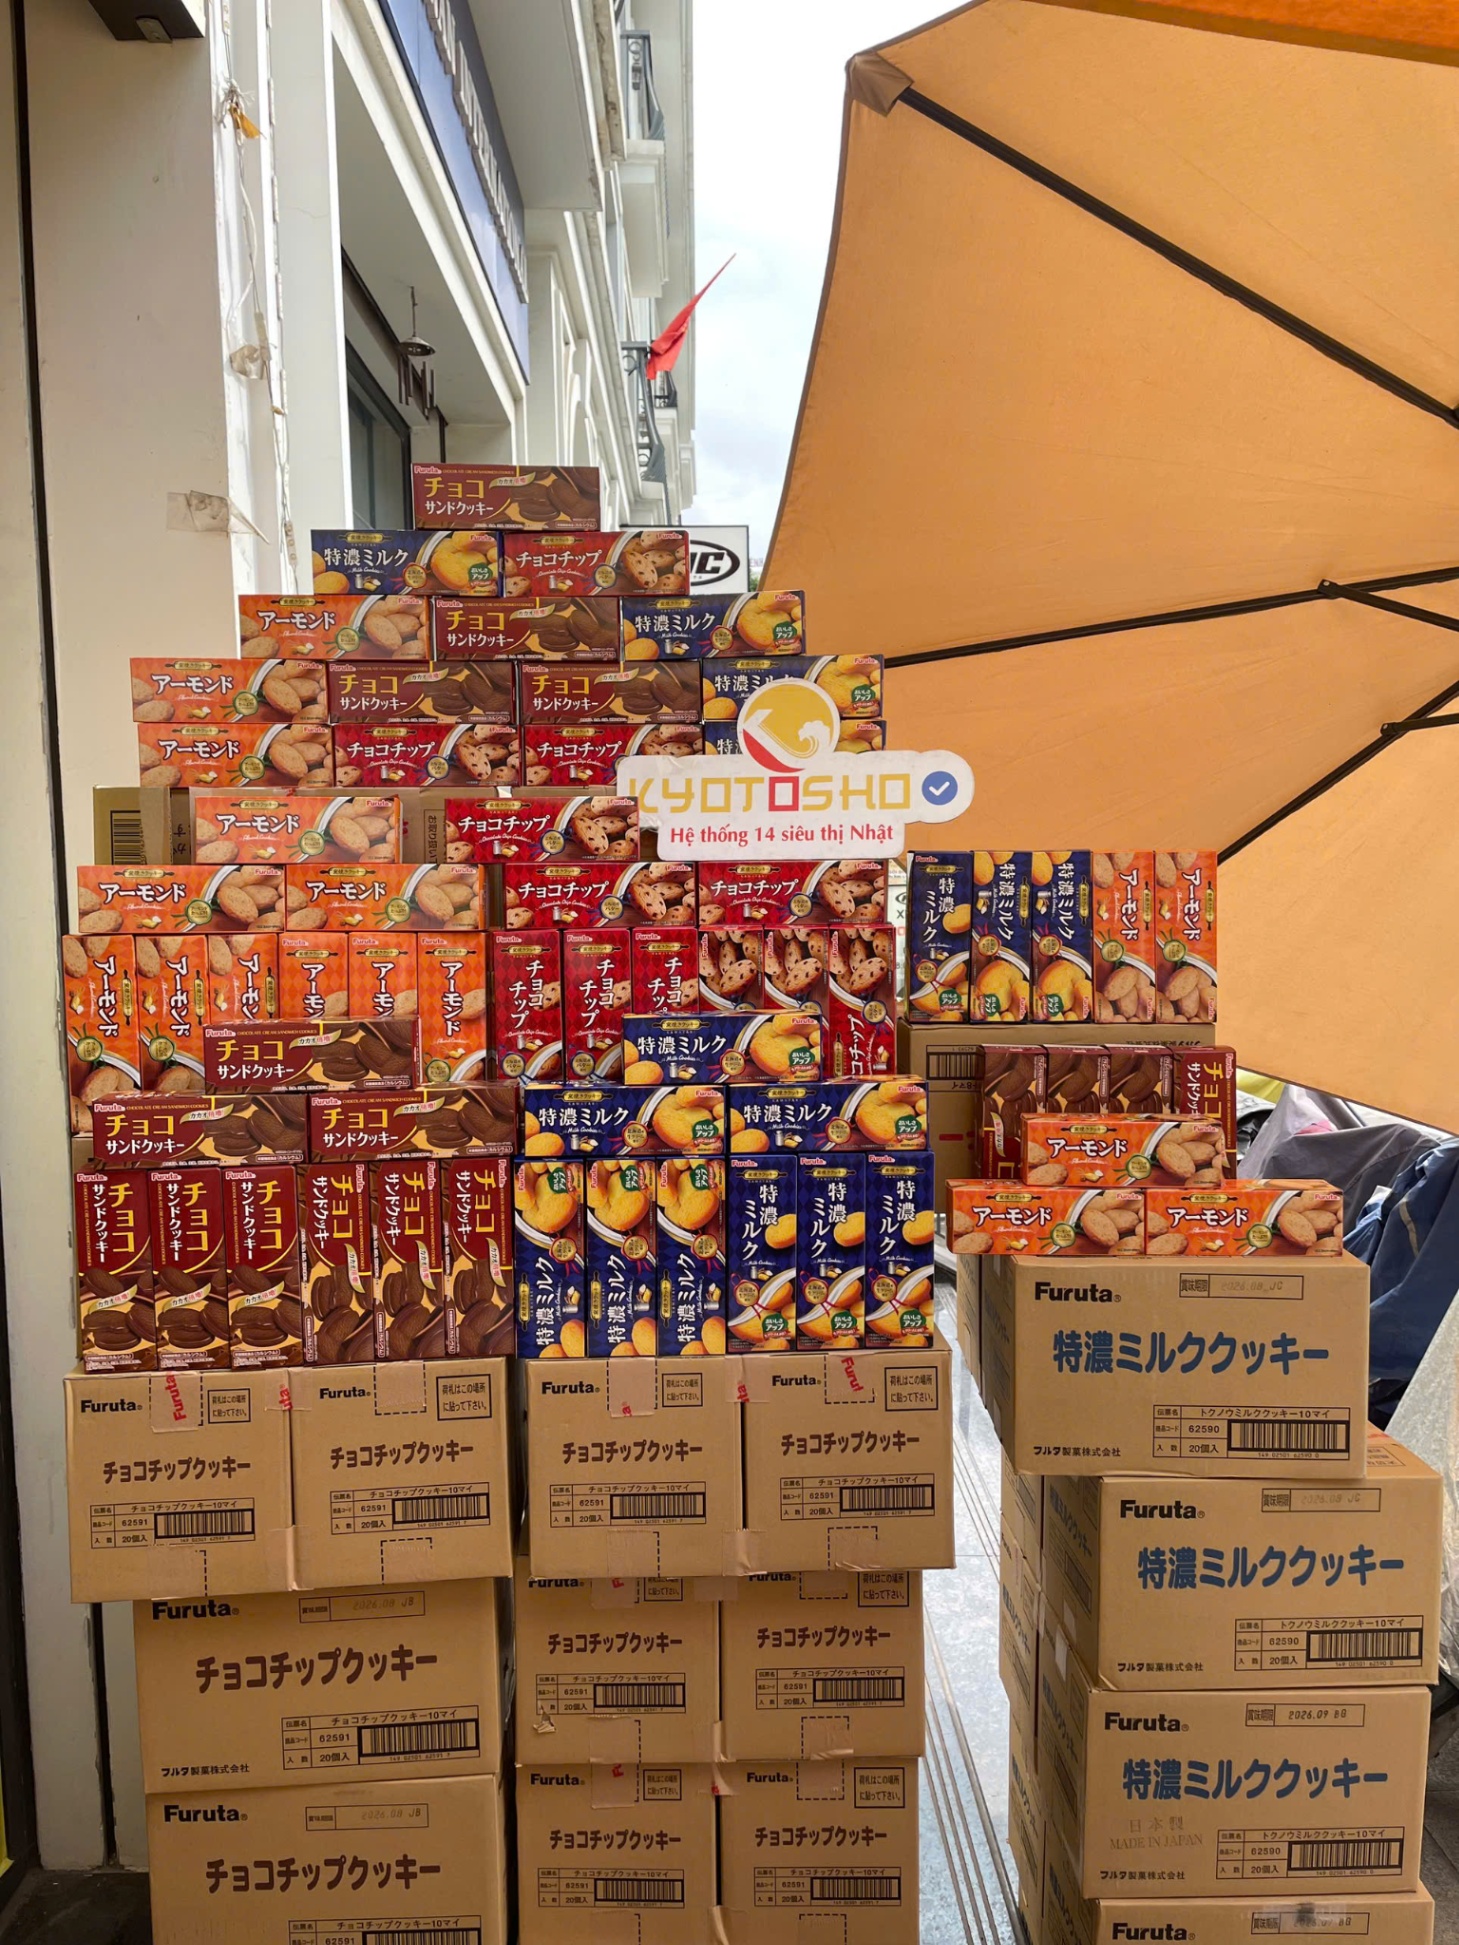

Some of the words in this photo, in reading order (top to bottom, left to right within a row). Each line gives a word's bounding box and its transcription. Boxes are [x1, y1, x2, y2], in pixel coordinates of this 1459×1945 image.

[424, 477, 484, 498] チョコ
[425, 501, 493, 516] サンドクッキー
[324, 548, 408, 567] 特濃ミルク
[516, 550, 602, 567] チョコチップ
[257, 611, 336, 631] アーモンド
[446, 610, 504, 630] チョコ
[635, 612, 715, 632] 特濃ミルク
[447, 633, 514, 647] サンドクッキー
[151, 674, 233, 694] アーモンド
[339, 674, 397, 694] チョコ
[532, 674, 589, 695] チョコ
[340, 697, 407, 710] サンドクッキー
[533, 697, 598, 711] サンドクッキー
[158, 739, 240, 759] アーモンド
[348, 742, 435, 758] チョコチップ
[537, 741, 622, 758] チョコチップ
[630, 774, 911, 813] KYOTOSHO
[216, 813, 300, 835] アーモンド
[458, 816, 550, 833] チョコチップ
[671, 828, 694, 843] Hệ
[701, 823, 748, 847] thống
[756, 826, 775, 842] 14
[782, 825, 814, 842] siêu
[821, 825, 843, 844] thị
[851, 824, 893, 846] Nhật
[99, 882, 186, 903] アーモンド
[306, 881, 387, 902] アーモンド
[519, 881, 609, 899] チョコチップ
[711, 879, 799, 897] チョコチップ
[938, 877, 956, 913] 特濃
[998, 863, 1015, 941] 特濃ミルク
[1058, 863, 1075, 940] 特濃ミルク
[1119, 868, 1139, 941] アーモンド
[1181, 868, 1202, 941] アーモンド
[922, 890, 940, 943] ミルク
[526, 960, 544, 1008] チョコ
[597, 959, 615, 1006] チョコ
[665, 957, 683, 1004] チョコ
[94, 955, 119, 1037] アーモンド
[166, 955, 191, 1037] アーモンド
[440, 961, 464, 1037] アーモンド
[509, 980, 530, 1028] チップ
[579, 979, 599, 1028] チップ
[216, 1040, 283, 1062] チョコ
[637, 1035, 727, 1055] 特濃ミルク
[217, 1064, 294, 1079] サンドクッキー
[1203, 1062, 1223, 1118] チョコ
[322, 1108, 388, 1130] チョコ
[539, 1107, 629, 1127] 特濃ミルク
[743, 1103, 833, 1123] 特濃ミルク
[105, 1114, 174, 1137] チョコ
[106, 1139, 185, 1155] サンドクッキー
[322, 1131, 399, 1148] サンドクッキー
[1047, 1138, 1127, 1159] アーモンド
[800, 1158, 826, 1166] Furuta
[869, 1155, 895, 1163] Furuta
[77, 1174, 108, 1182] Furuta
[151, 1172, 182, 1181] Furuta
[226, 1171, 256, 1180] Furuta
[331, 1174, 354, 1238] チョコ
[384, 1173, 401, 1246] サンドクッキー
[402, 1172, 426, 1235] チョコ
[456, 1171, 473, 1243] サンドクッキー
[473, 1169, 497, 1233] チョコ
[759, 1185, 779, 1226] 特濃
[827, 1182, 847, 1224] 特濃
[896, 1181, 916, 1222] 特濃
[108, 1183, 135, 1253] チョコ
[166, 1183, 183, 1261] サンドクッキー
[182, 1181, 209, 1252] チョコ
[241, 1181, 256, 1260] サンドクッキー
[256, 1180, 282, 1249] チョコ
[312, 1176, 330, 1249] サンドクッキー
[972, 1206, 1052, 1227] アーモンド
[1167, 1207, 1249, 1228] アーモンド
[92, 1184, 109, 1263] サンドクッキー
[741, 1199, 762, 1261] ミルク
[810, 1197, 831, 1259] ミルク
[879, 1195, 900, 1256] ミルク
[535, 1256, 555, 1345] 特濃ミルク
[607, 1255, 626, 1344] 特濃ミルク
[677, 1253, 696, 1343] 特濃ミルク
[1035, 1281, 1113, 1303] Furuta
[1053, 1330, 1329, 1376] 特濃ミルククッキー
[772, 1375, 816, 1386] Furuta
[842, 1357, 864, 1392] Furut
[164, 1372, 187, 1421] Furuta
[320, 1386, 366, 1400] Furuta
[542, 1381, 594, 1394] Furuta
[81, 1399, 137, 1413] Furuta
[1156, 1407, 1179, 1417] 伝票名
[1200, 1408, 1331, 1419] トクノウミルククッキー10マイ
[1188, 1424, 1220, 1435] 62590
[562, 1439, 702, 1464] チョコチップクッキー
[781, 1430, 920, 1456] チョコチップクッキー
[1033, 1445, 1121, 1458] フルタ製菓株式会社
[1189, 1443, 1219, 1454] 20個入
[330, 1440, 473, 1469] チョコチップクッキー
[103, 1456, 251, 1484] チョコチップクッキー
[370, 1485, 473, 1499] チョコチップクッキー10マイ
[131, 1500, 238, 1513] チョコチップクッキー10マイ
[361, 1504, 386, 1512] 62591
[579, 1499, 604, 1507] 62591
[1120, 1500, 1197, 1519] Furuta
[361, 1521, 386, 1529] 20個入
[579, 1515, 603, 1523] 20個入
[122, 1534, 148, 1543] 20個入
[1137, 1543, 1404, 1590] 特濃ミルククッキー
[152, 1601, 231, 1621] Furuta
[1280, 1617, 1404, 1630] トクノウミルククッキー10マイ
[548, 1632, 682, 1655] チョコチップクッキー
[757, 1626, 891, 1648] チョコチップクッキー
[1269, 1636, 1299, 1646] 62590
[196, 1644, 438, 1694] チョコチップクッキー
[1117, 1662, 1204, 1673] フルタ製菓株式会社
[331, 1709, 457, 1726] チョコチップクッキー10マイ
[1105, 1712, 1181, 1732] Furuta
[1288, 1709, 1329, 1721] 2026.09
[319, 1733, 350, 1743] 62591
[319, 1752, 350, 1763] 20個入
[161, 1763, 250, 1778] フルタ製菓株式会社
[531, 1773, 579, 1786] Furuta
[747, 1772, 789, 1783] Furuta
[1122, 1757, 1388, 1800] 特濃ミルククッキー
[164, 1804, 240, 1822] Furuta
[550, 1829, 681, 1851] チョコチップクッキー
[755, 1825, 887, 1847] チョコチップクッキー
[1110, 1837, 1145, 1851] MADE
[1148, 1836, 1161, 1849] IN
[1164, 1833, 1203, 1848] JAPAN
[1262, 1829, 1385, 1839] トクノウミルククッキー10マイ
[206, 1854, 441, 1894] チョコチップクッキー
[1100, 1870, 1185, 1880] フルタ製菓株式会社
[1112, 1922, 1187, 1941] Furuta
